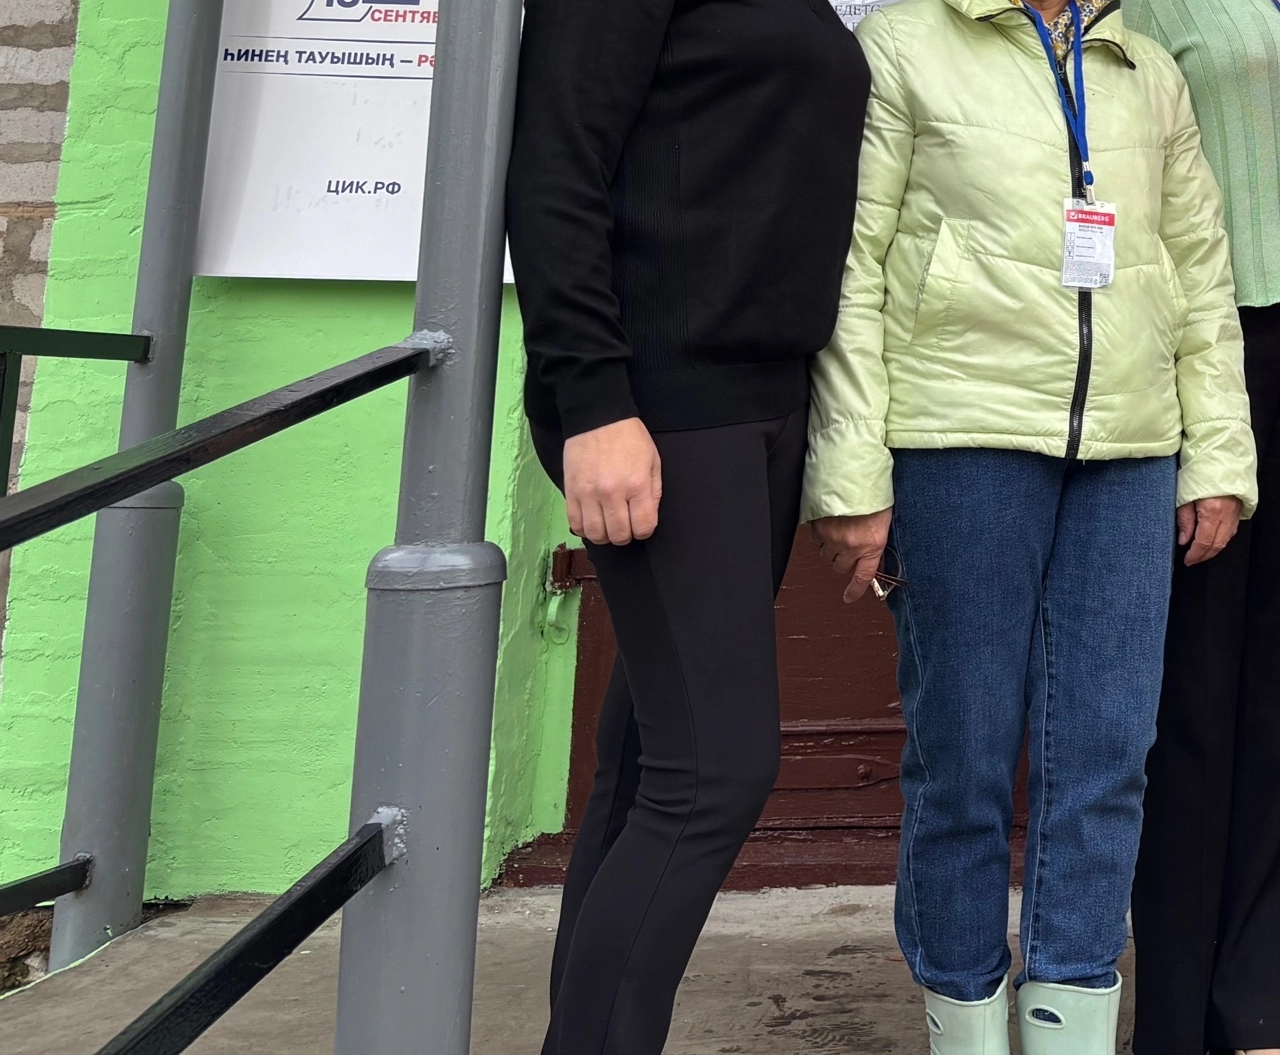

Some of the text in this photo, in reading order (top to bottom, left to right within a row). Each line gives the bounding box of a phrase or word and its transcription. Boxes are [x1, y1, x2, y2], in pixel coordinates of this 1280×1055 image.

[835, 5, 880, 17] ЕДЕТС
[223, 48, 289, 65] ҺИНЕҢ
[295, 50, 395, 68] ТАУЫШЫҢ
[326, 180, 402, 196] ЦИК.РФ
[1078, 212, 1109, 222] BRAUBERG
